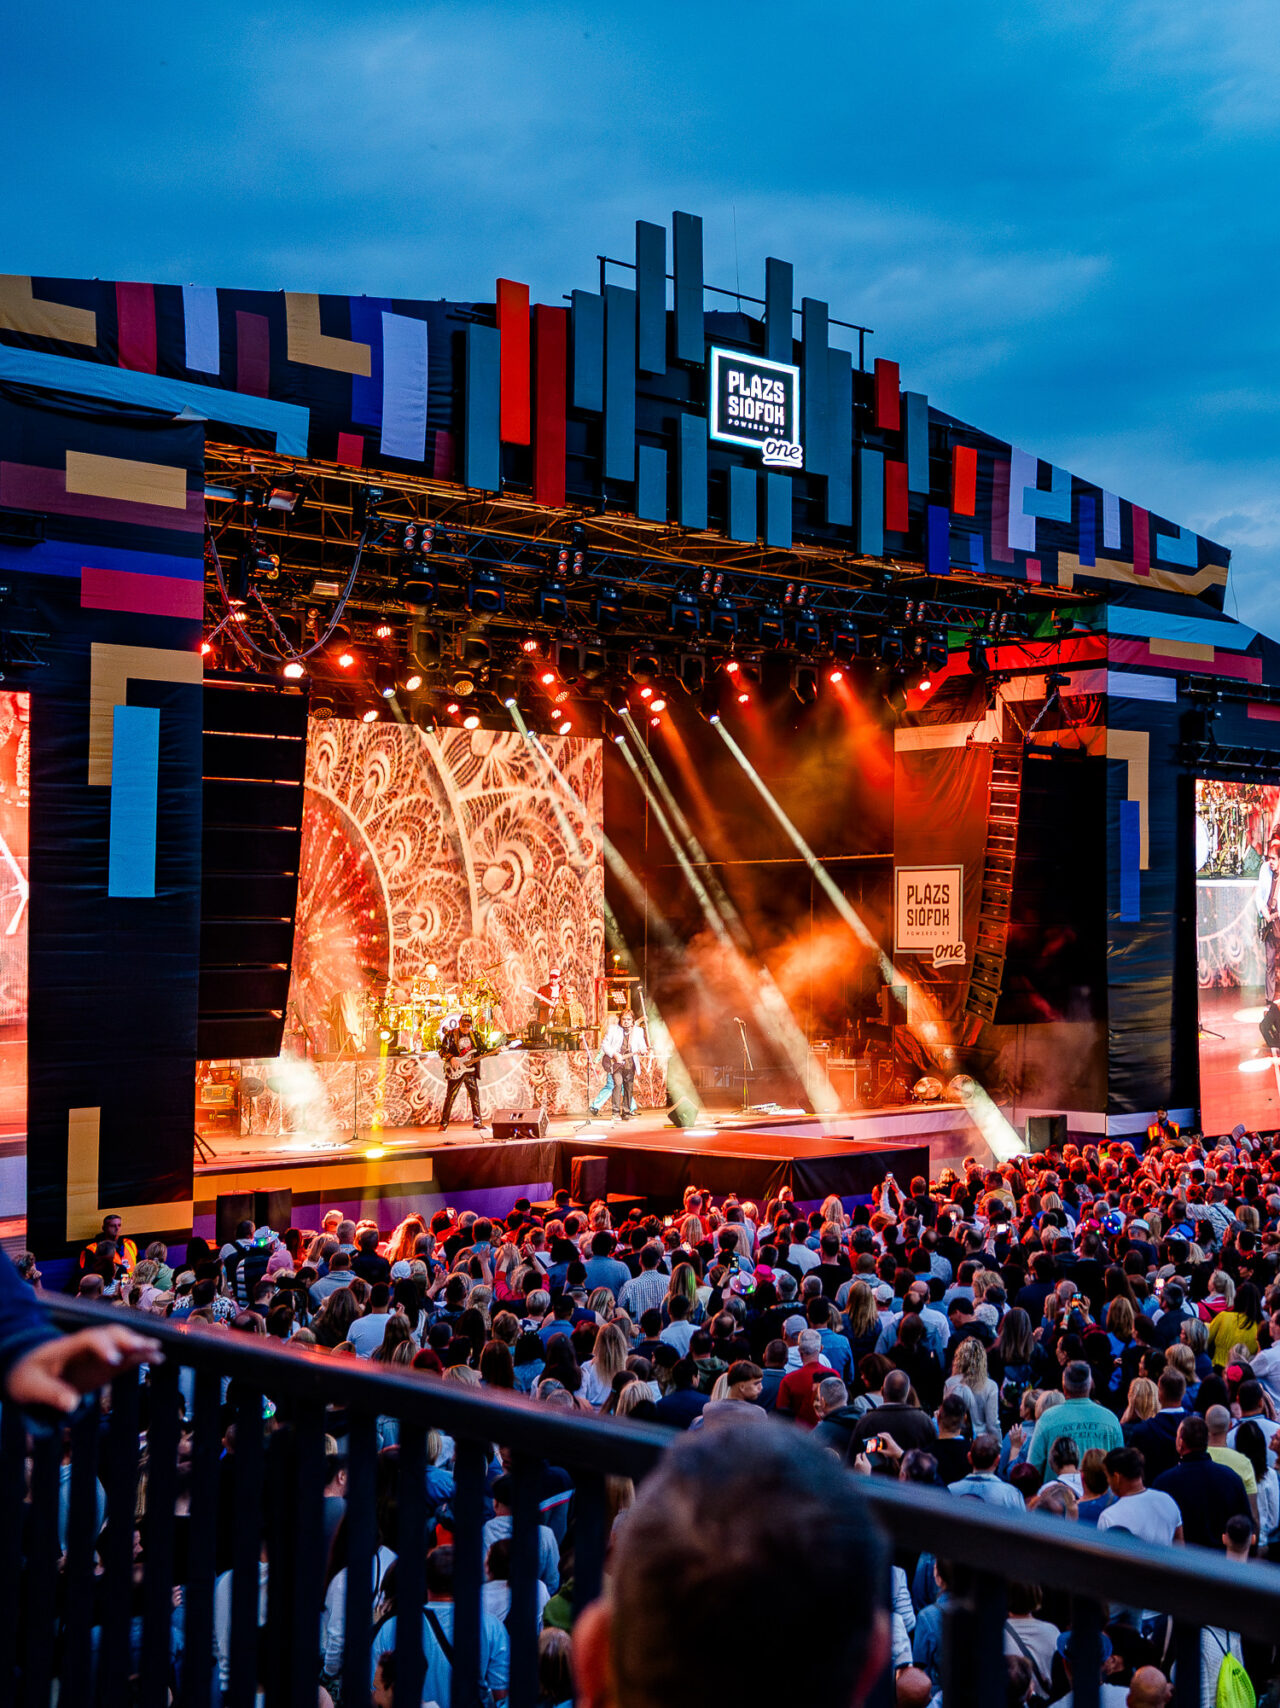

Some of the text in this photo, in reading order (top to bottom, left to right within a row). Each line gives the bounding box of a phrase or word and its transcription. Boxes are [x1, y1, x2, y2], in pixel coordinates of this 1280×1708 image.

[728, 418, 785, 436] POWERED BY
[766, 441, 799, 460] one
[935, 944, 964, 959] one
